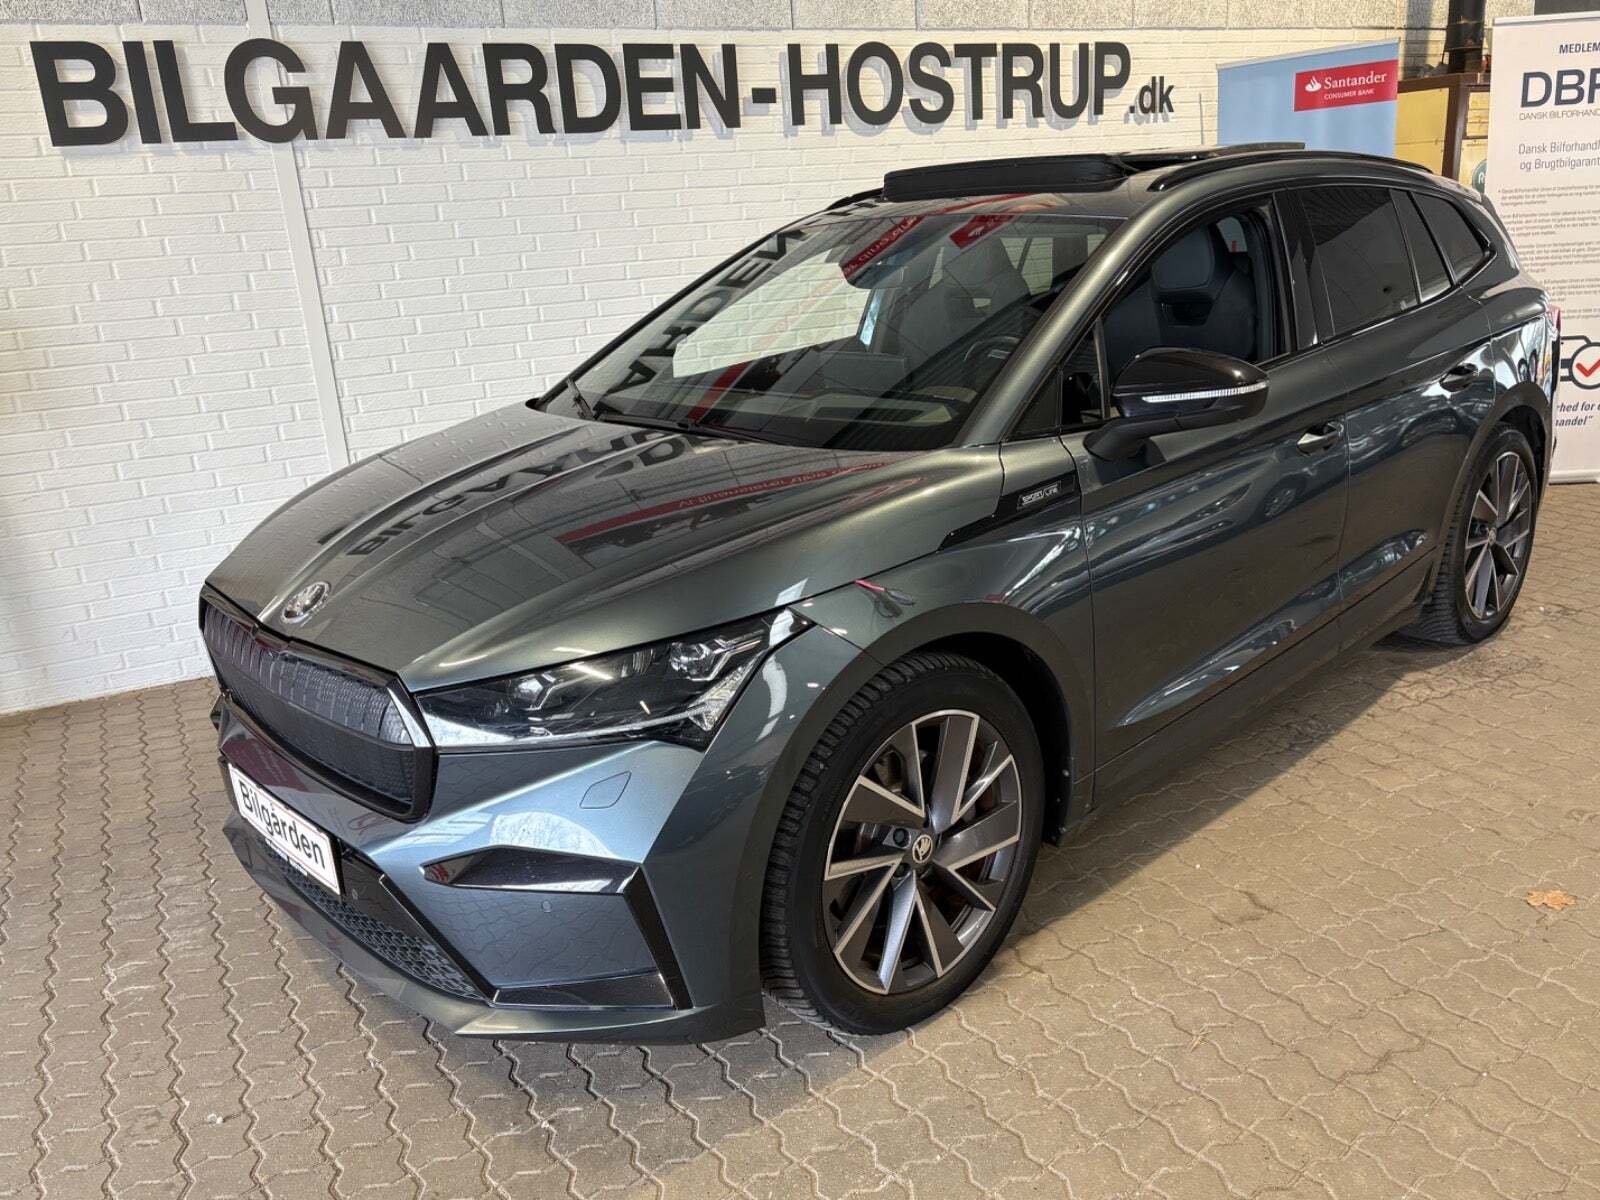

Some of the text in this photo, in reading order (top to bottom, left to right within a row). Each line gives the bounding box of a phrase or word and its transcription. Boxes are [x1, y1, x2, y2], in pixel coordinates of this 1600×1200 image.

[1323, 70, 1387, 89] Santander
[1323, 88, 1375, 100] CONSUMER BANK
[1519, 111, 1548, 120] DANSK
[1519, 142, 1548, 154] Dansk
[1520, 161, 1532, 172] og
[1581, 401, 1596, 411] for
[238, 778, 326, 870] Bilgården
